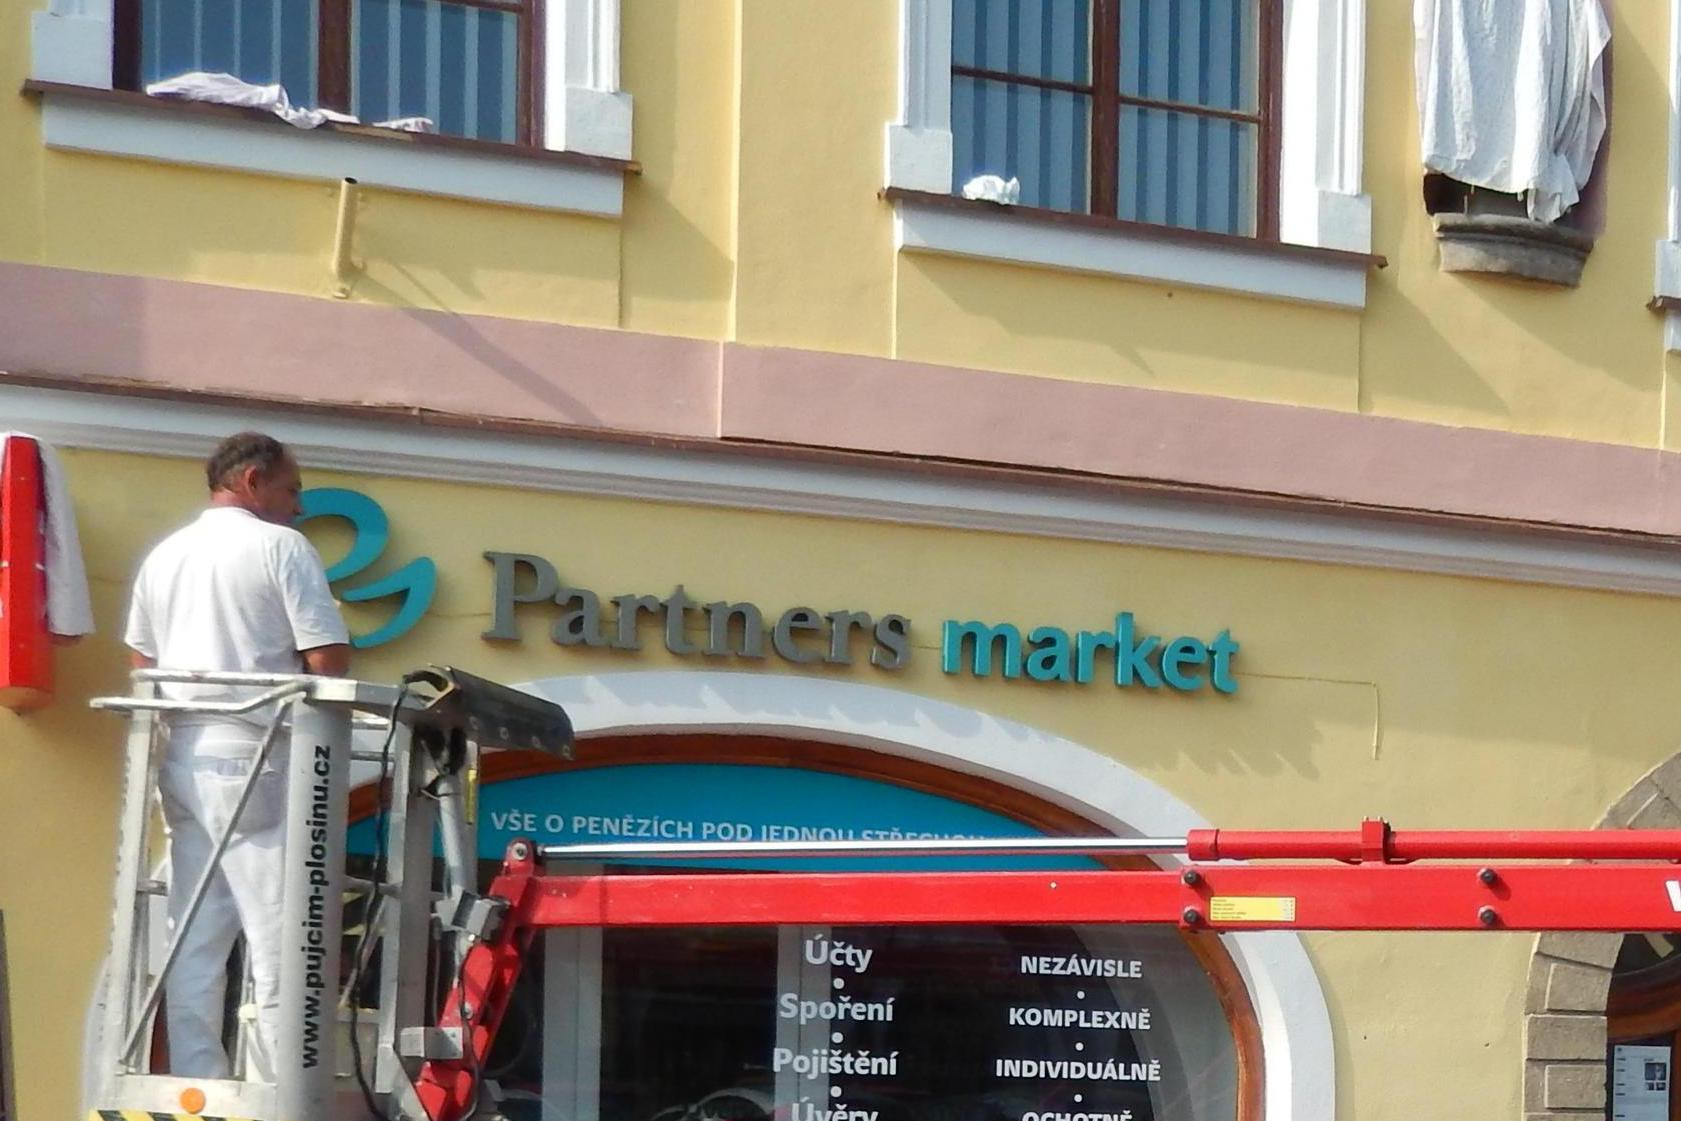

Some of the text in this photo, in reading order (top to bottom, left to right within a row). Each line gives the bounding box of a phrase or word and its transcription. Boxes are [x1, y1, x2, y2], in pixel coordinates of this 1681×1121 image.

[481, 550, 1239, 695] Partners market
[491, 809, 536, 832] VŠE
[545, 813, 565, 833] O
[572, 814, 693, 839] PENĚZÍCH
[702, 821, 753, 842] POD
[299, 744, 332, 1070] www.pujcim-plosinu.cz
[805, 935, 873, 973] Účty
[1020, 955, 1142, 978] NEZÁVISLE
[779, 992, 894, 1023] Spoření
[1009, 1007, 1151, 1031] KOMPLEXNĚ
[773, 1047, 898, 1079] Pojištění
[996, 1058, 1161, 1081] INDIVIDUÁLNĚ
